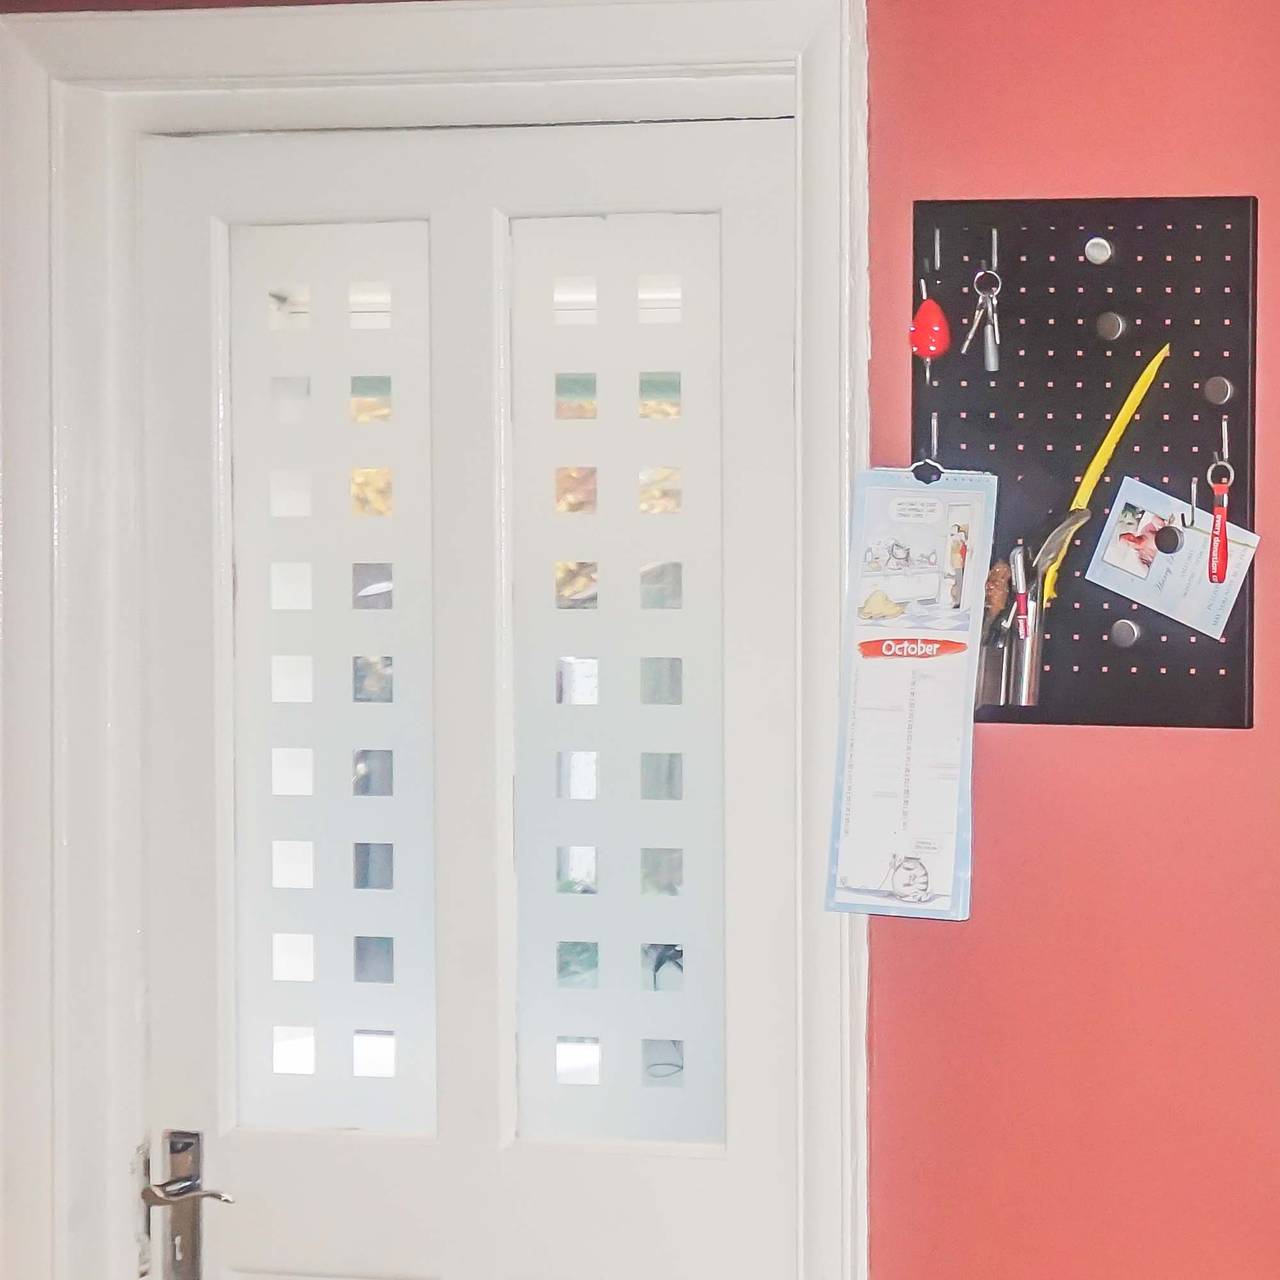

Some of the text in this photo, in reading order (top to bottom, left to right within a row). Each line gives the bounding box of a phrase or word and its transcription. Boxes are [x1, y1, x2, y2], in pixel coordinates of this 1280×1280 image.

[1213, 515, 1221, 535] every
[1211, 537, 1220, 573] donation
[882, 639, 940, 656] October
